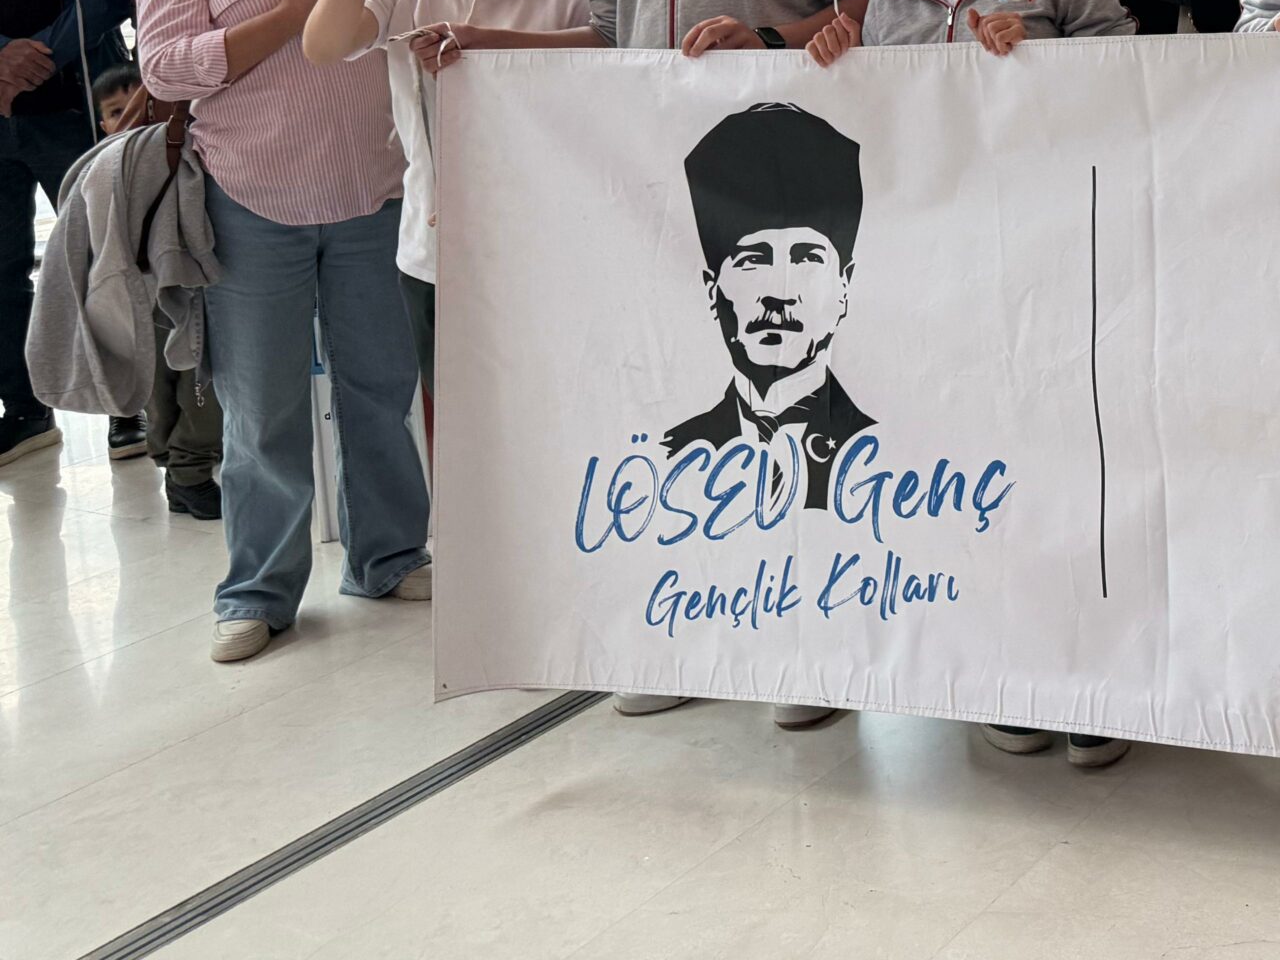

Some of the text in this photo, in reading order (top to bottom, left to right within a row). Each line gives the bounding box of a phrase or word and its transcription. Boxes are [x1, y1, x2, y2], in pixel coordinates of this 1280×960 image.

[574, 431, 1017, 553] LÖSEV Genç
[645, 550, 959, 638] Gençlik Kolları
